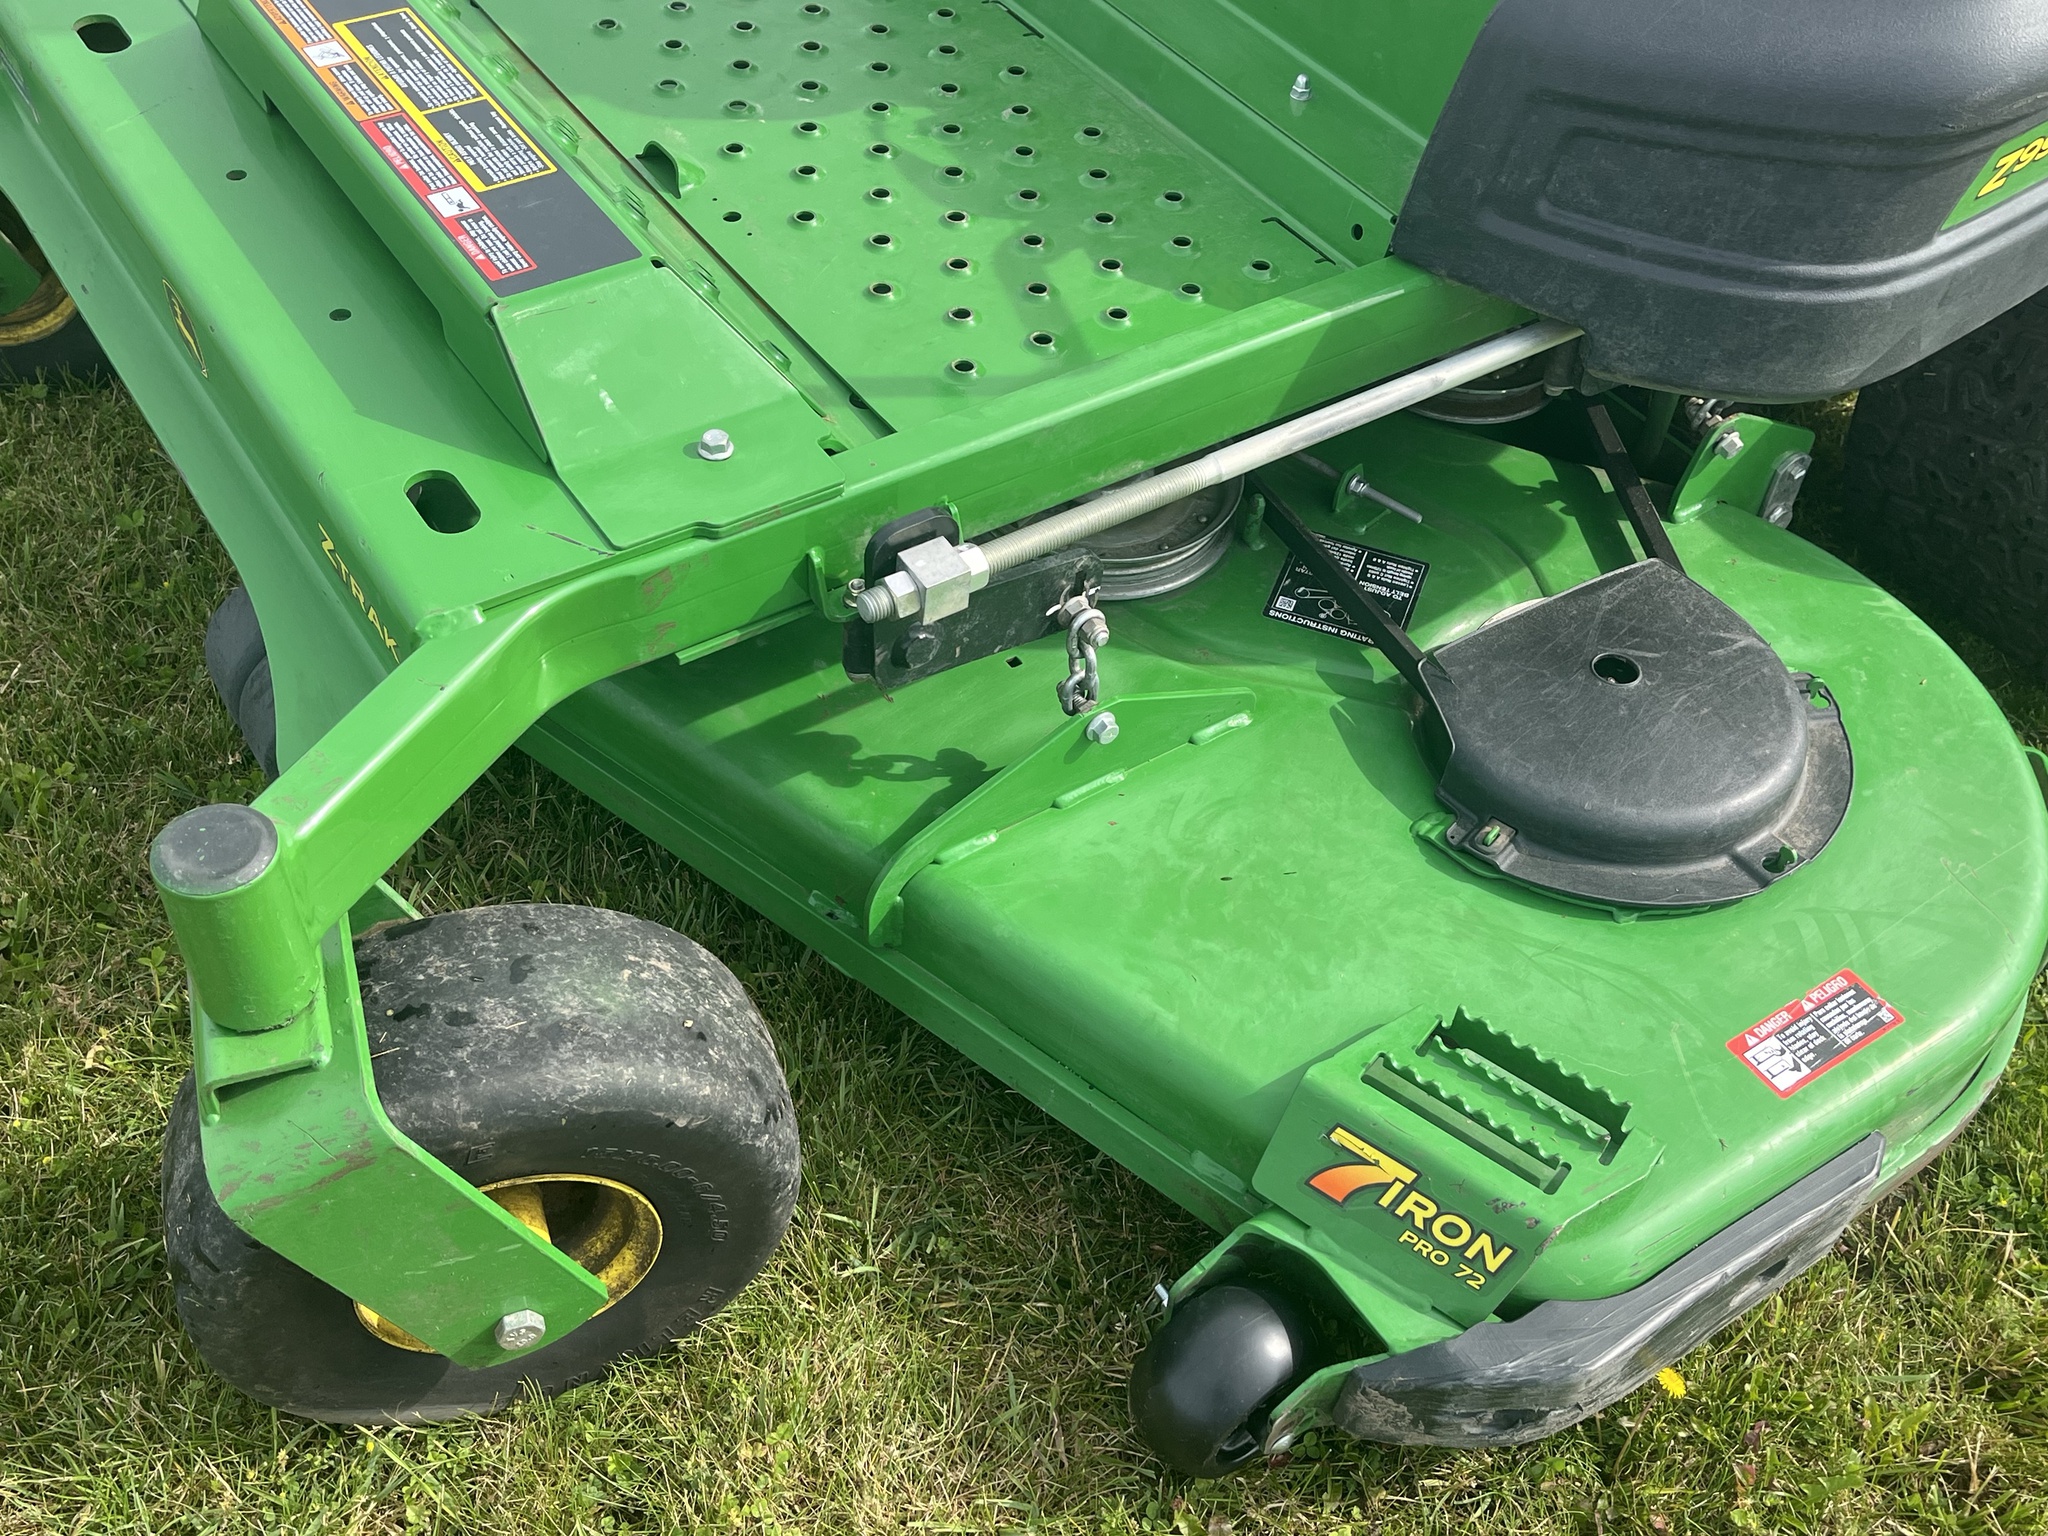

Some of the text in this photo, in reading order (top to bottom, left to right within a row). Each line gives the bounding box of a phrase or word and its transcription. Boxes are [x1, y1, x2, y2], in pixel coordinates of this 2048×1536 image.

[1359, 581, 1389, 592] TENSION
[1268, 609, 1338, 634] INSTRUCTIONS
[1809, 976, 1848, 1003] PELIGRO
[1754, 1011, 1792, 1038] DANGER
[1398, 1230, 1487, 1291] PRO 72
